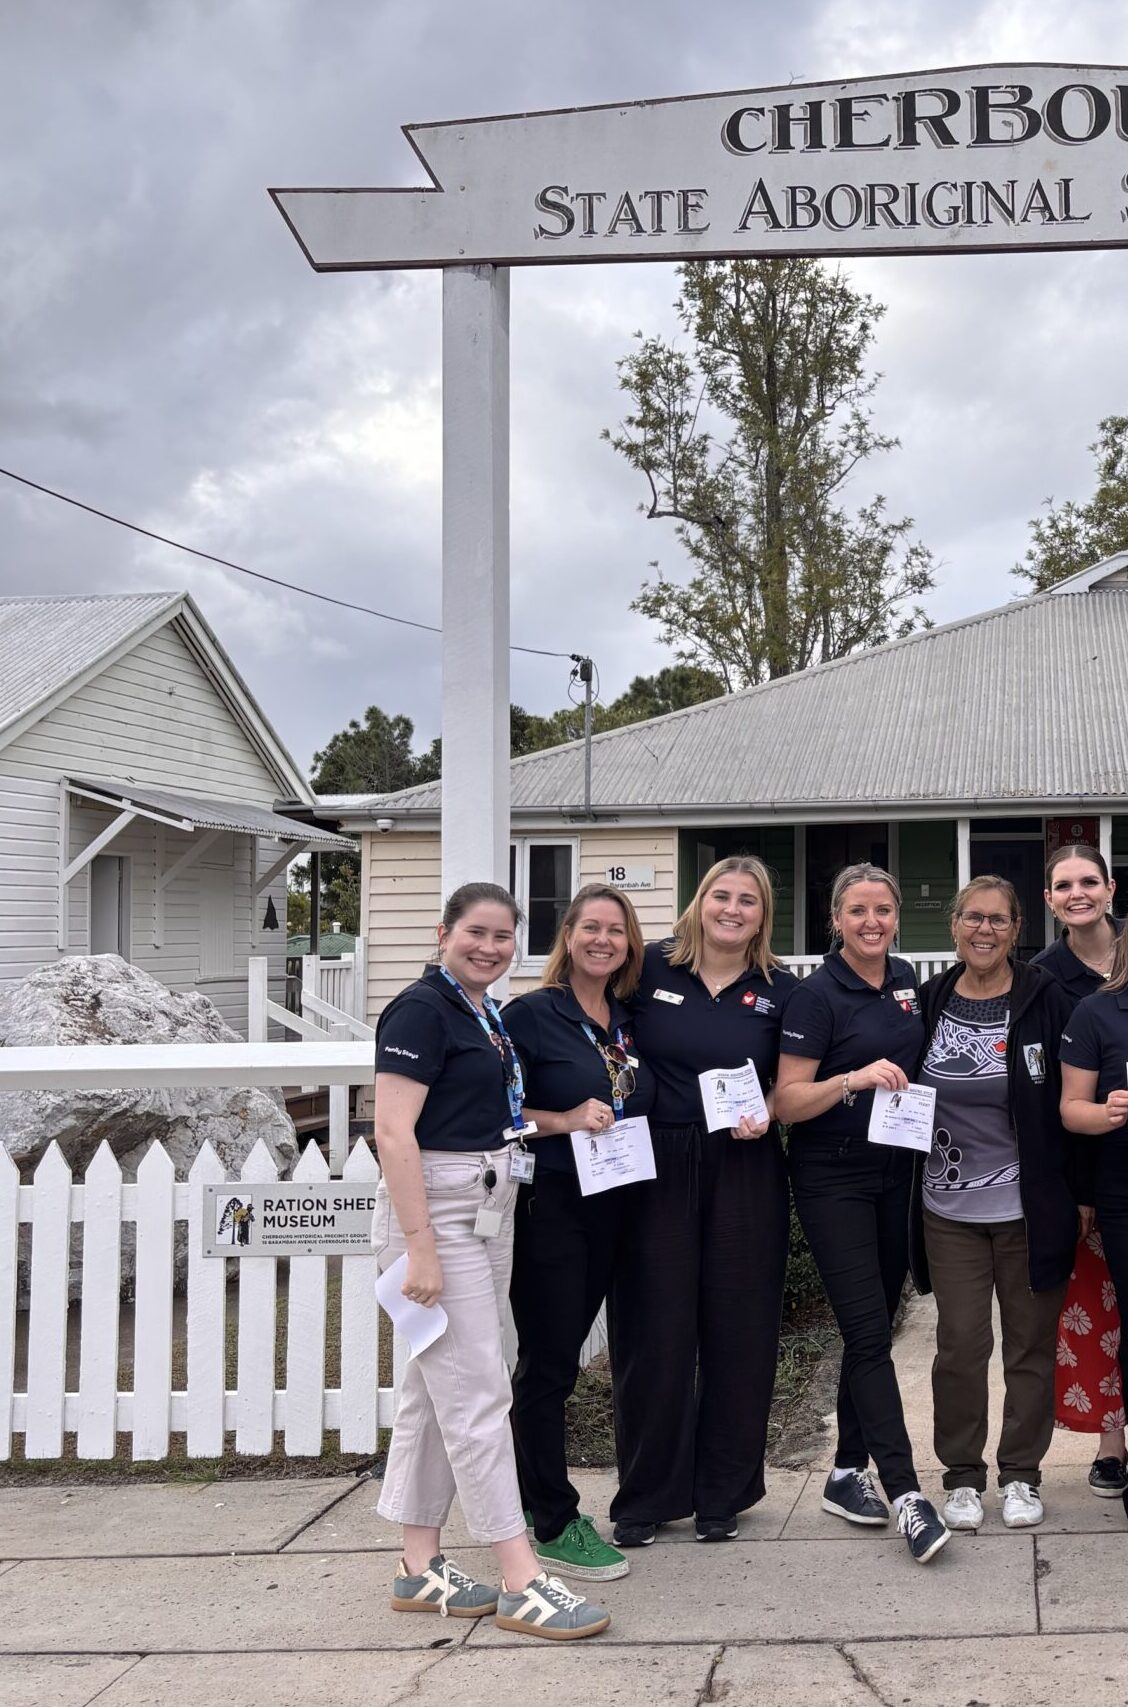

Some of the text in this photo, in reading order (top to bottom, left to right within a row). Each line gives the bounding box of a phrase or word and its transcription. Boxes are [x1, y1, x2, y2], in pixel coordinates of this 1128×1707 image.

[534, 185, 712, 240] STATE
[733, 177, 1092, 233] ABORIGINAL
[609, 867, 625, 880] 18
[263, 1198, 376, 1212] RATION SHED
[263, 1214, 335, 1228] MUSEUM
